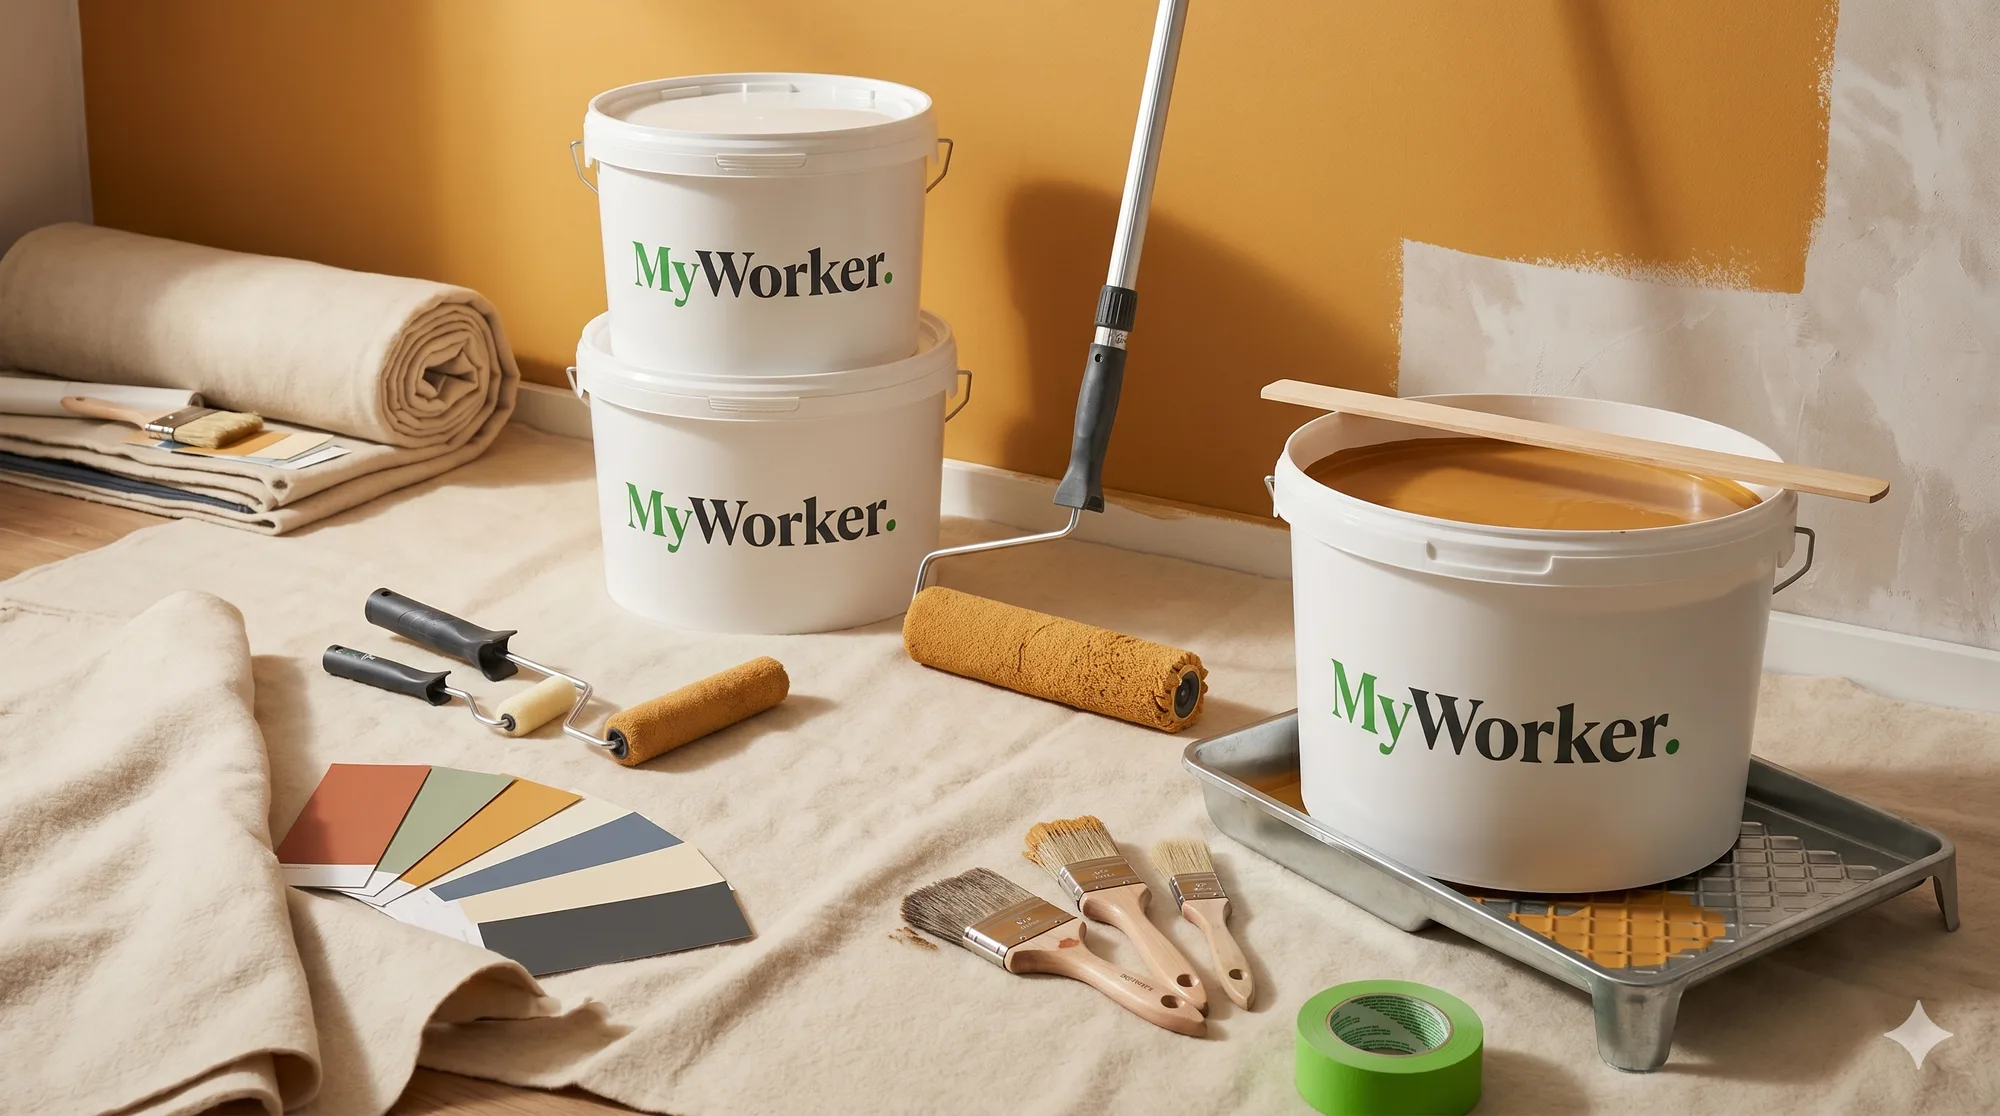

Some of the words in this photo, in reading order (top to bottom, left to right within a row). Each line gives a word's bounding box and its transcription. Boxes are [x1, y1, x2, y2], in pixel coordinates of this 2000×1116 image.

[632, 240, 894, 308] MyWorker.
[625, 481, 897, 553] MyWorker.
[1331, 657, 1681, 764] MyWorker.
